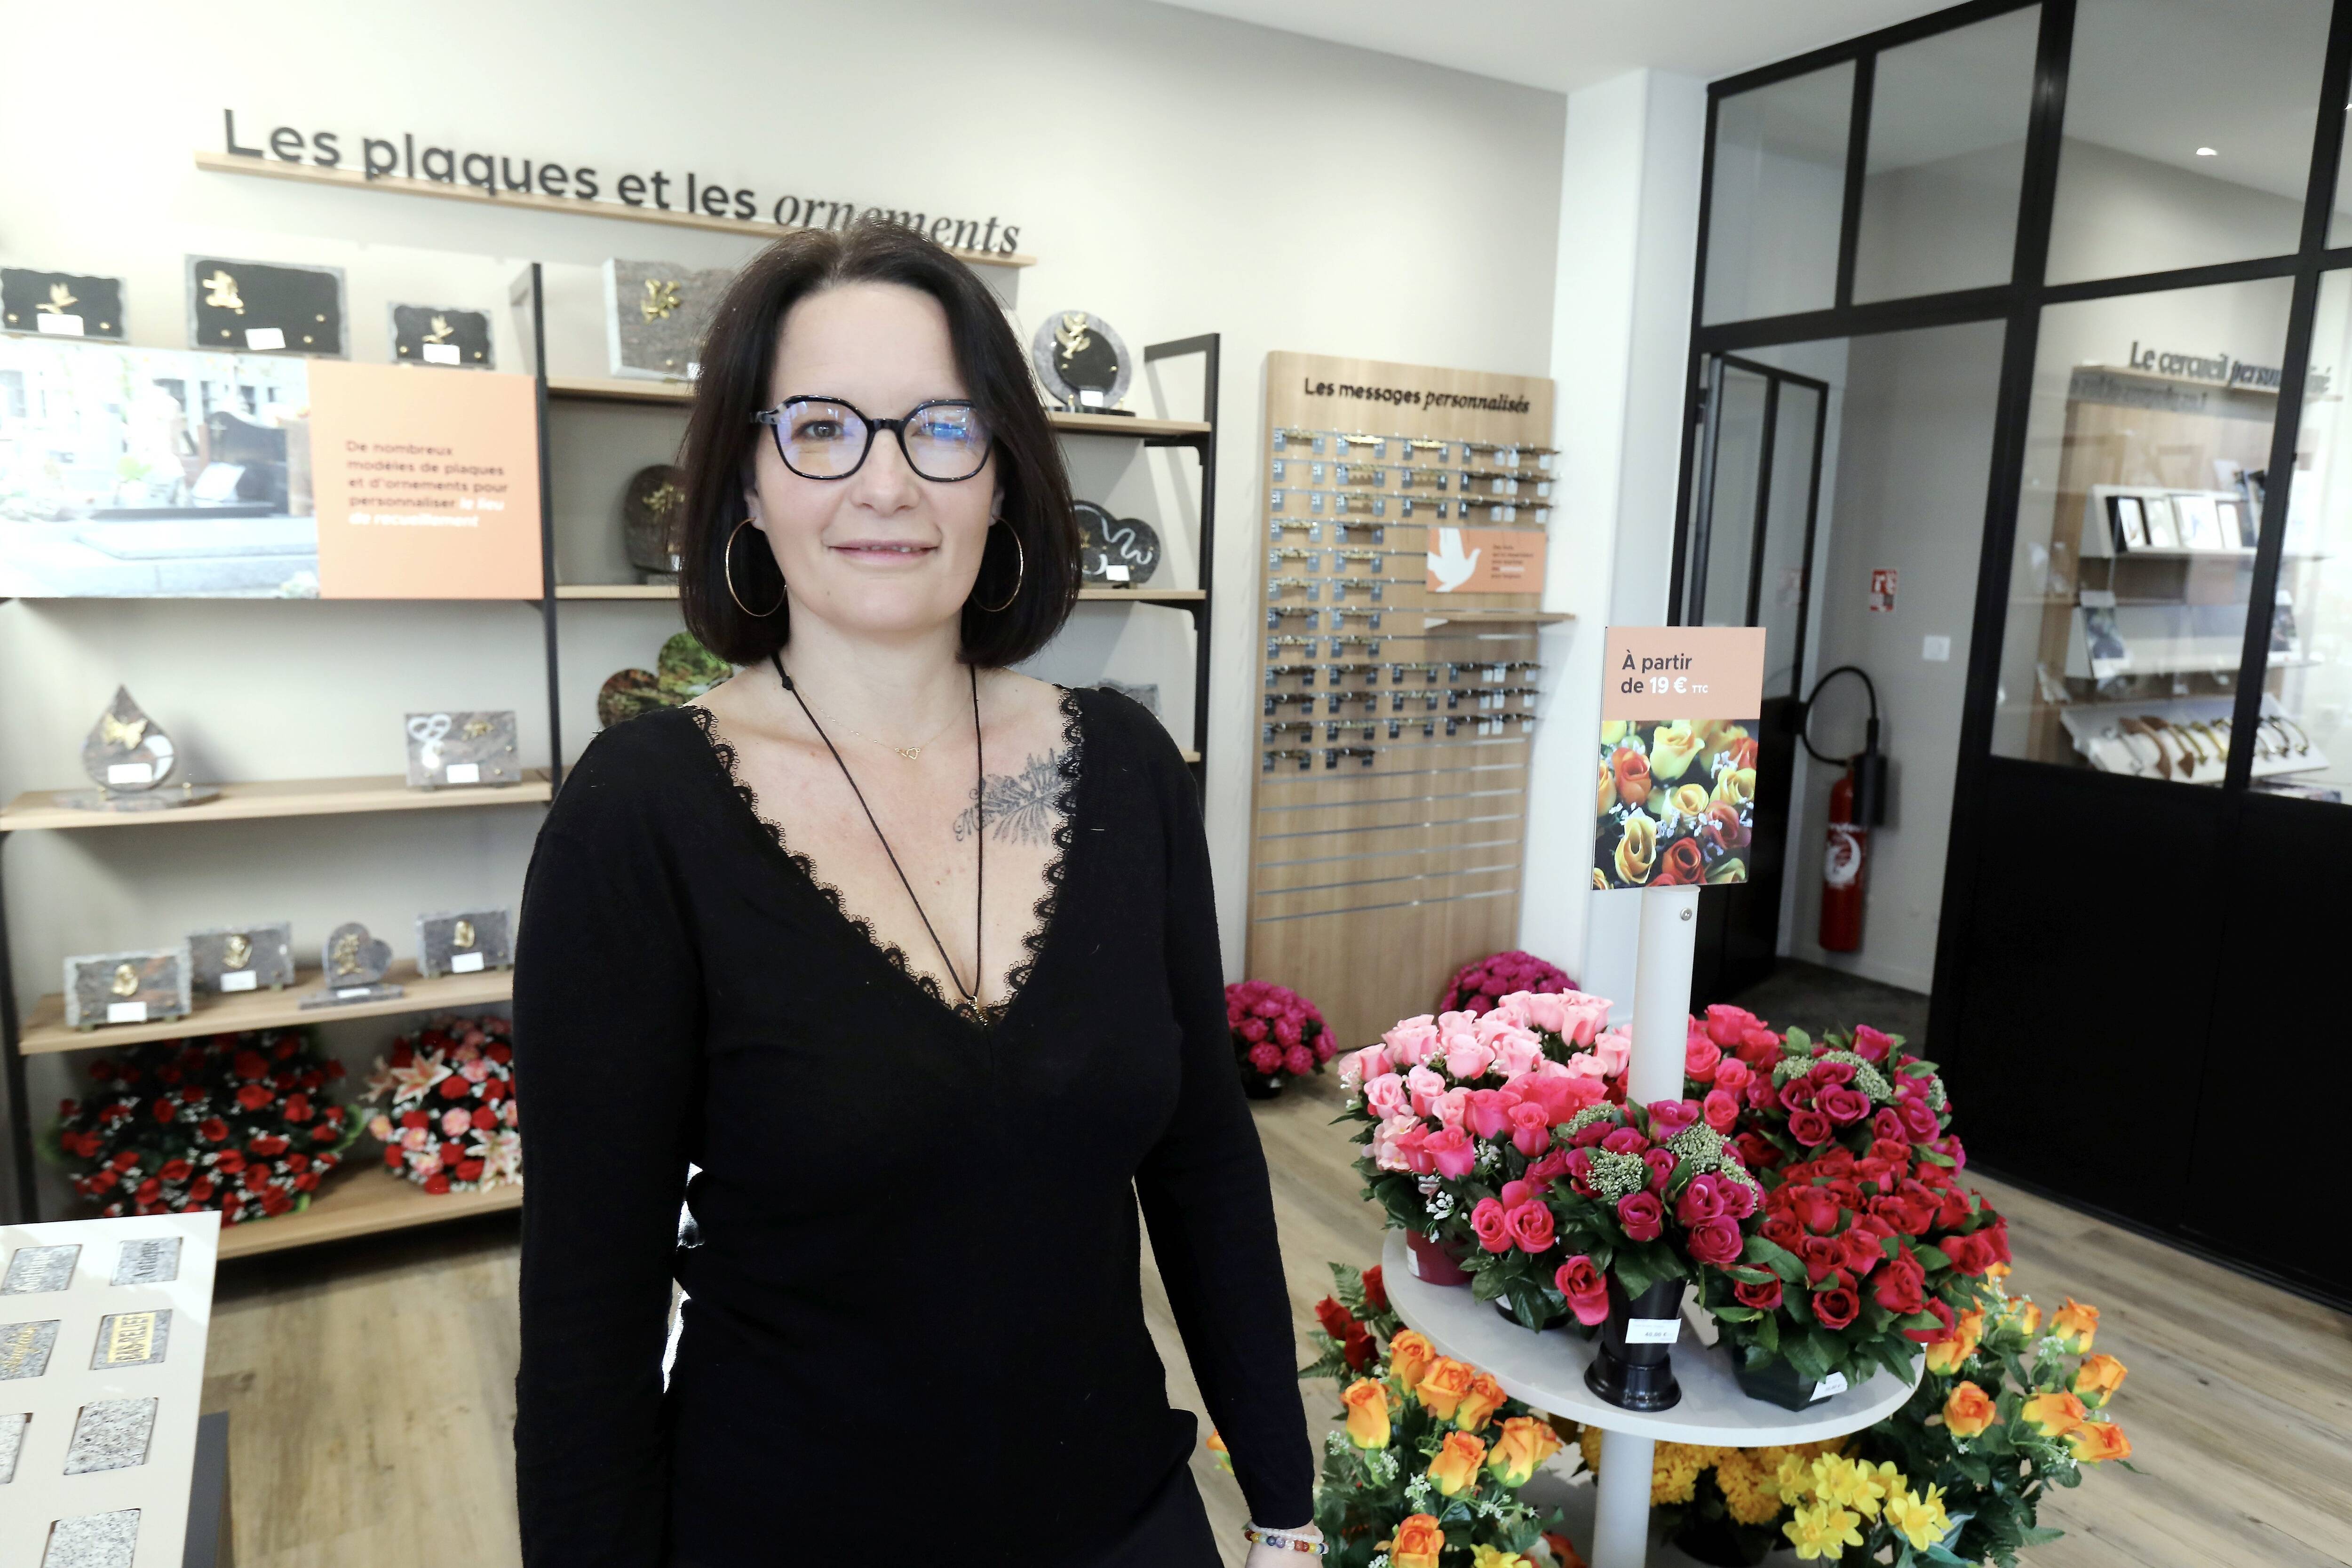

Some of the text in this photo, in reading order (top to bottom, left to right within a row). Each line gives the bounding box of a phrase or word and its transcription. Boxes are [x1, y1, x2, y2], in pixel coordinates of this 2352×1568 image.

[223, 109, 342, 167] Les
[362, 133, 599, 200] plaques
[617, 170, 670, 210] et
[687, 172, 756, 220] les
[2129, 340, 2155, 370] Le
[1304, 377, 1530, 414] Les messages personnalisés
[346, 440, 367, 452] De
[347, 460, 505, 476] modèles de plaques
[349, 478, 363, 488] et
[473, 483, 508, 494] pour
[349, 495, 454, 509] personnaliser
[1621, 649, 1692, 674] À partir
[1621, 677, 1708, 694] de 19 € TTC
